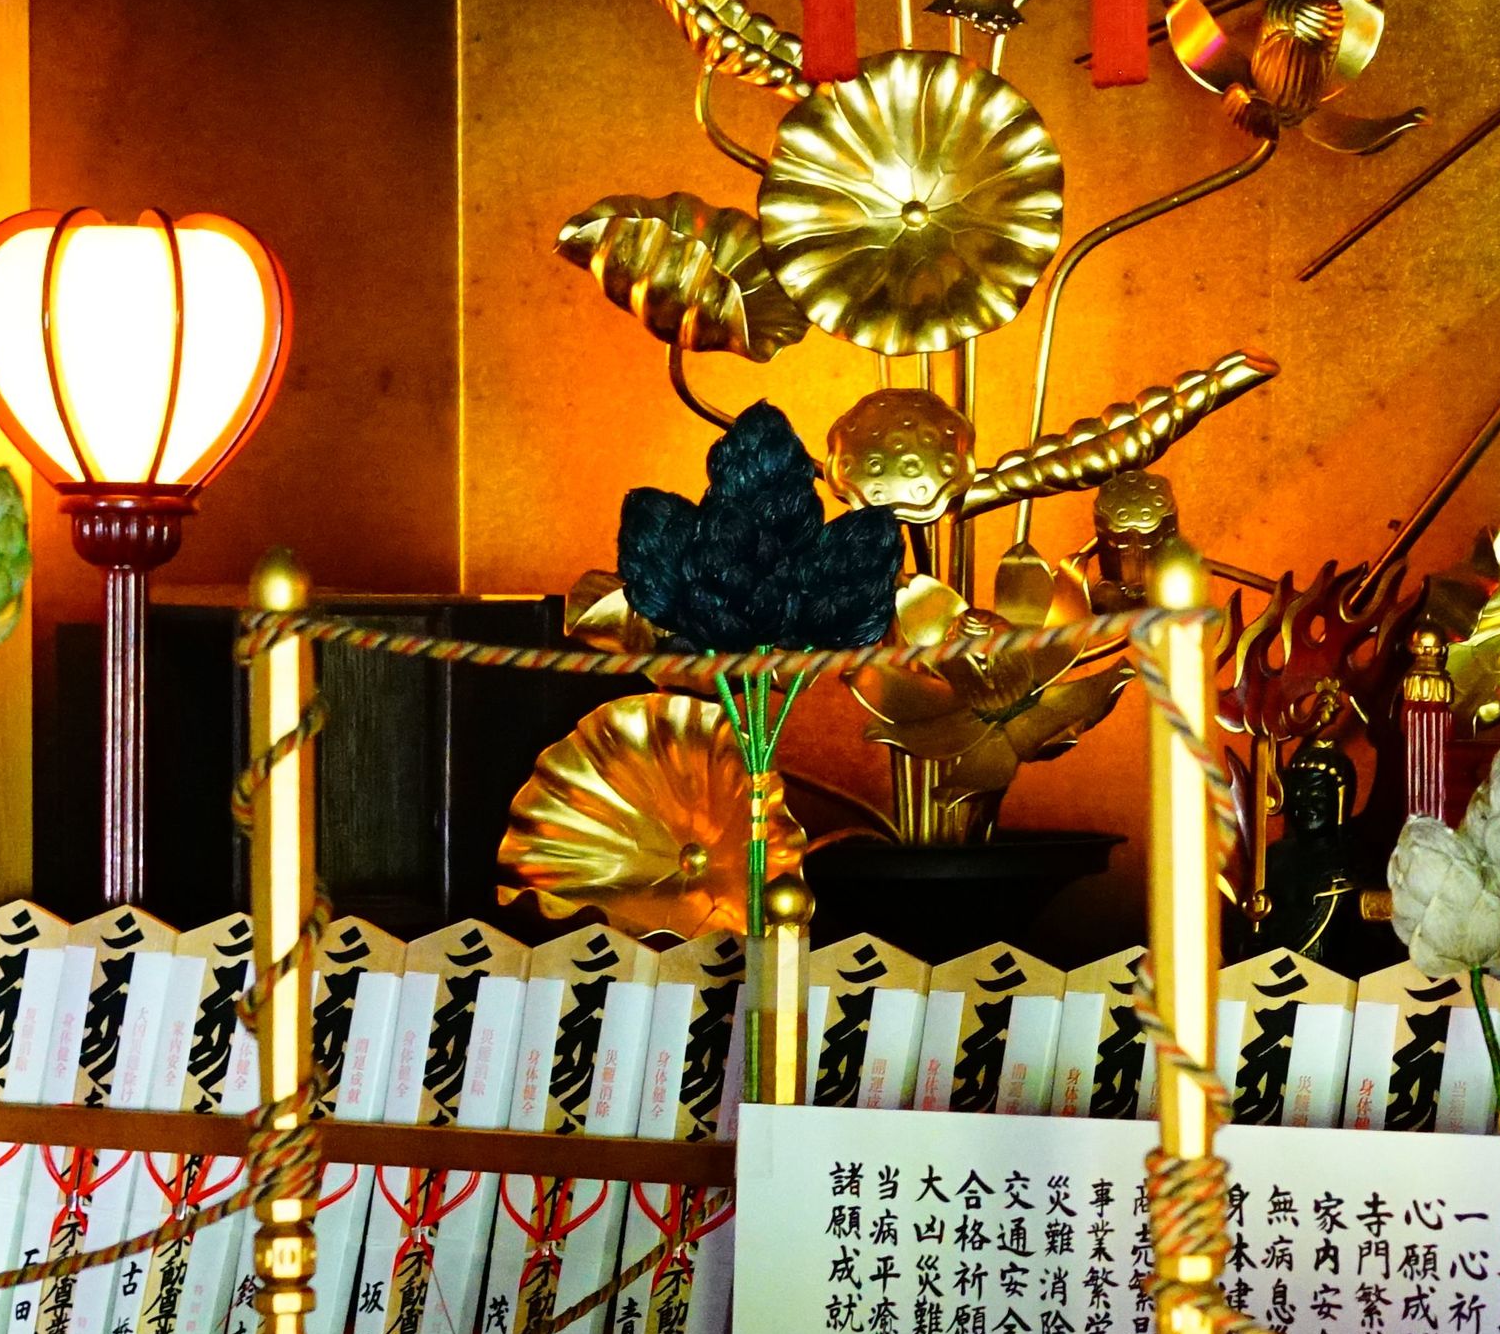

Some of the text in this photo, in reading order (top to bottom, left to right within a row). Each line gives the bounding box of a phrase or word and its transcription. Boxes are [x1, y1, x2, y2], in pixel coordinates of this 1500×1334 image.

[521, 1049, 541, 1115] 身体健全
[651, 1049, 671, 1118] 身体健全
[824, 1161, 864, 1333] 諸願成就
